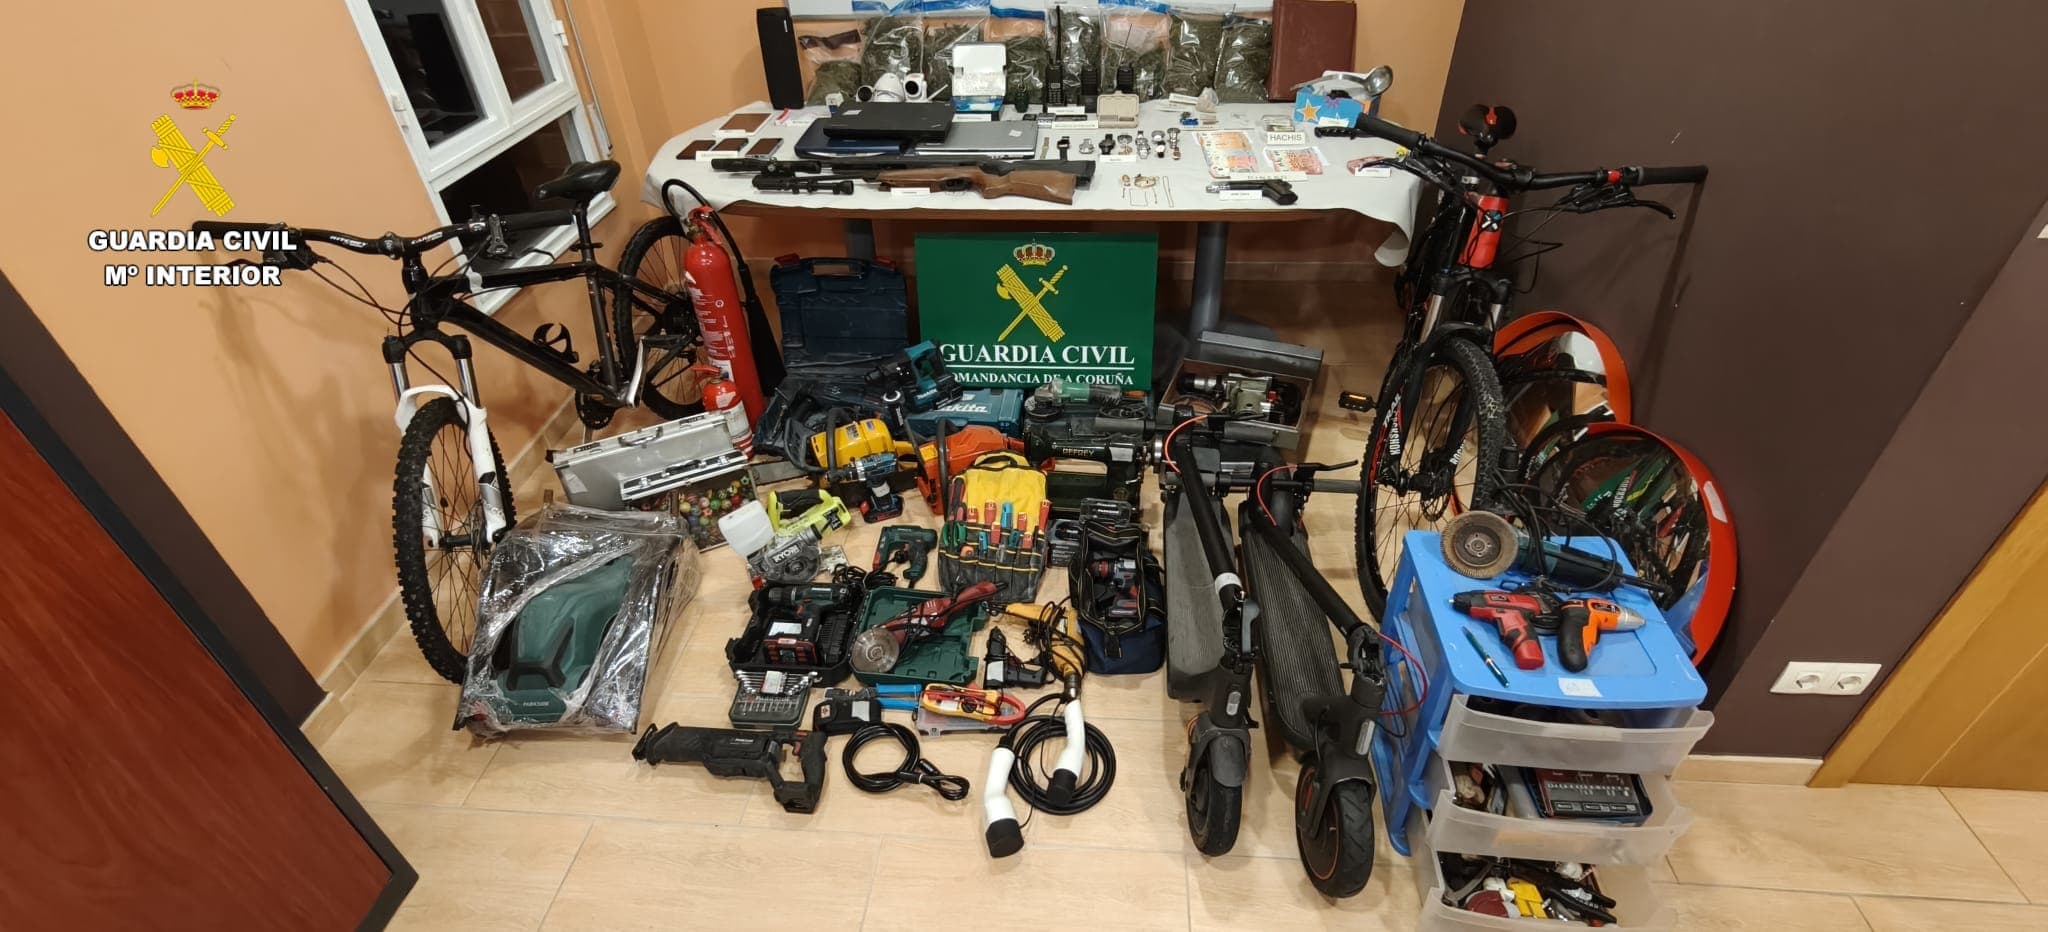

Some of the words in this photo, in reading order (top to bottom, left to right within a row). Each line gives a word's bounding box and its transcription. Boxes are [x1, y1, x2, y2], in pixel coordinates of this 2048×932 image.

[940, 343, 1056, 363] GUARDIA
[1062, 345, 1135, 364] CIVIL
[952, 372, 1040, 384] OMANDANCIA
[1076, 372, 1134, 385] CORUÑA
